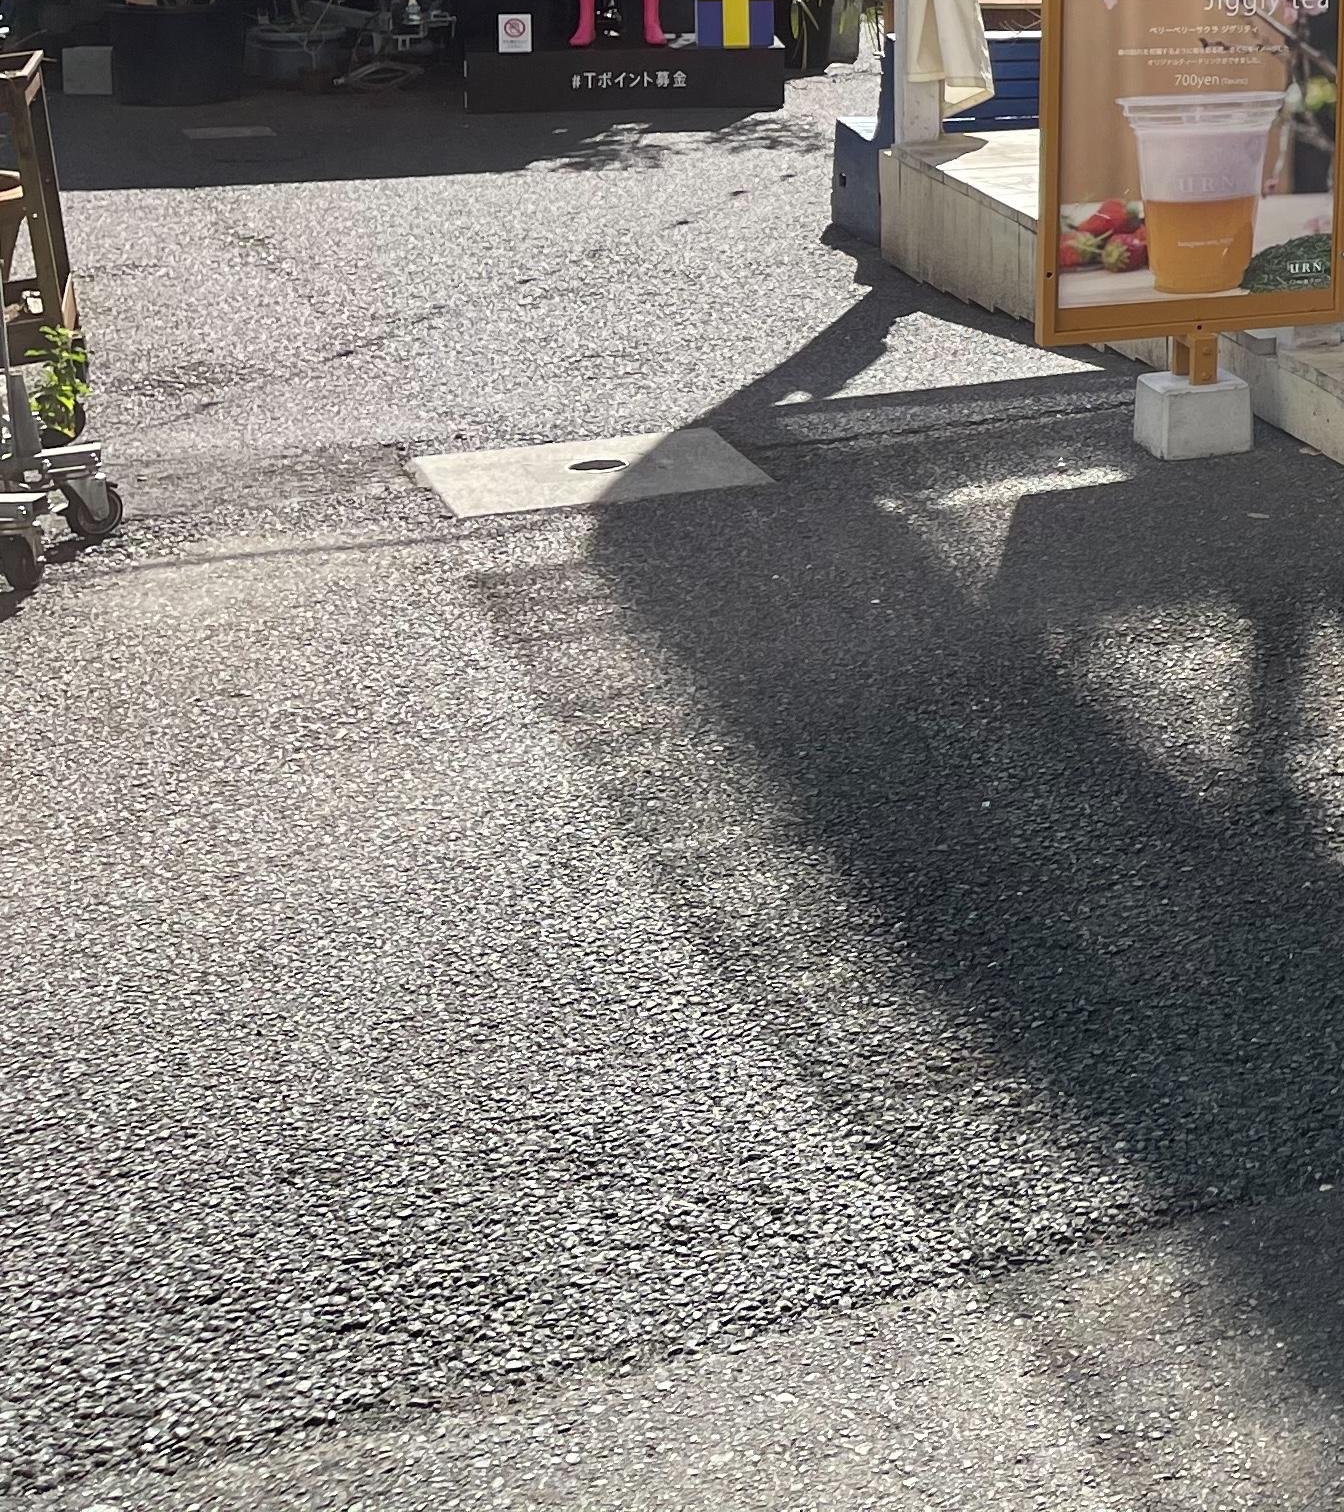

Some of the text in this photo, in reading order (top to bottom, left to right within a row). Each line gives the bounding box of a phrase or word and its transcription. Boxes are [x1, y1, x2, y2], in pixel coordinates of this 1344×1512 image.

[571, 70, 688, 89] #Tポイント募金
[1174, 73, 1220, 88] 700yen
[1290, 262, 1322, 273] URN
